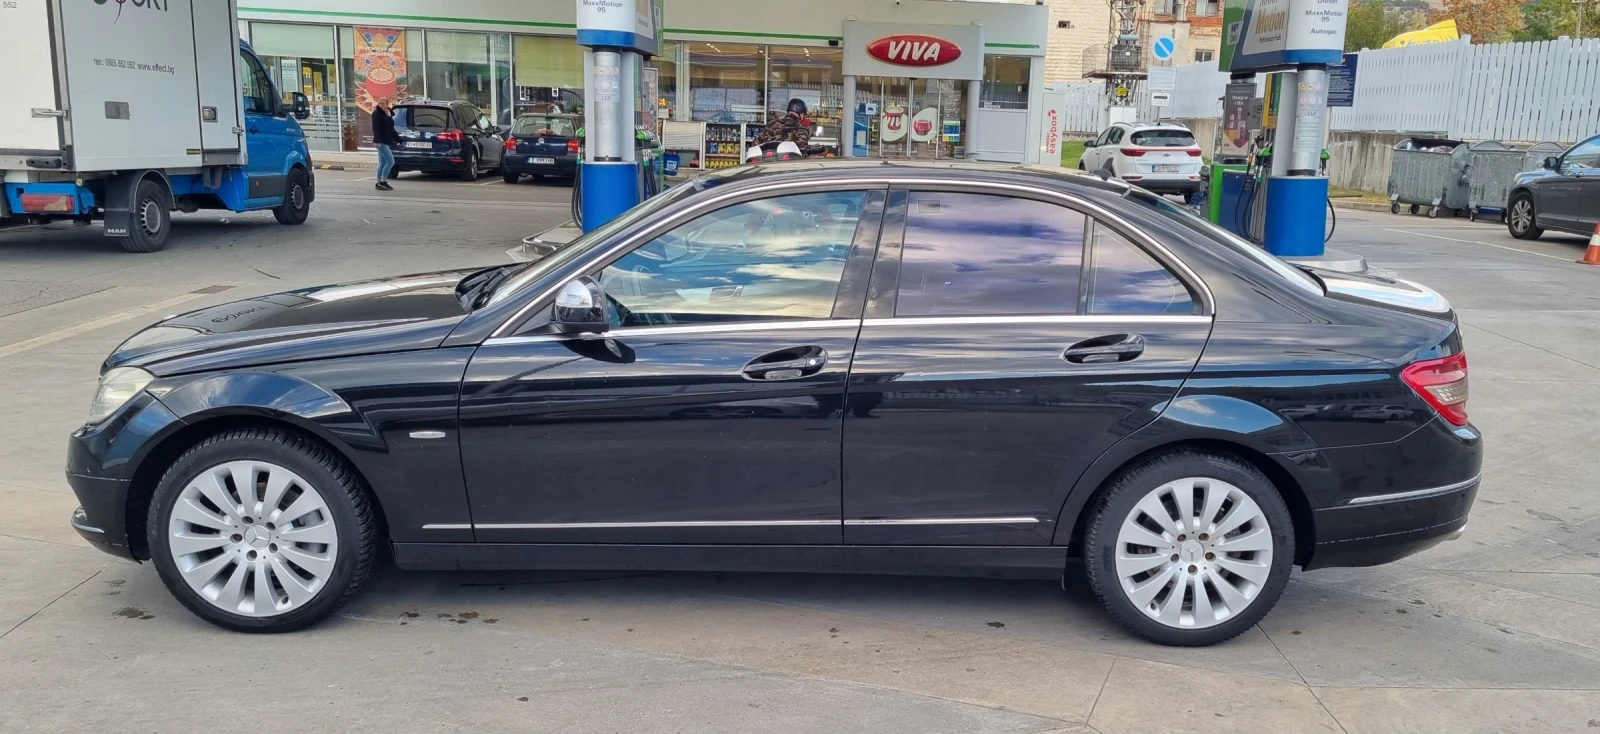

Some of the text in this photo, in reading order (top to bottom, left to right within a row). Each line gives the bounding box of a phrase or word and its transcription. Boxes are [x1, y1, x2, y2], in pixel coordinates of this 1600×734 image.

[1255, 7, 1285, 34] Motion
[888, 39, 941, 61] VIVA
[1049, 115, 1057, 154] easybox
